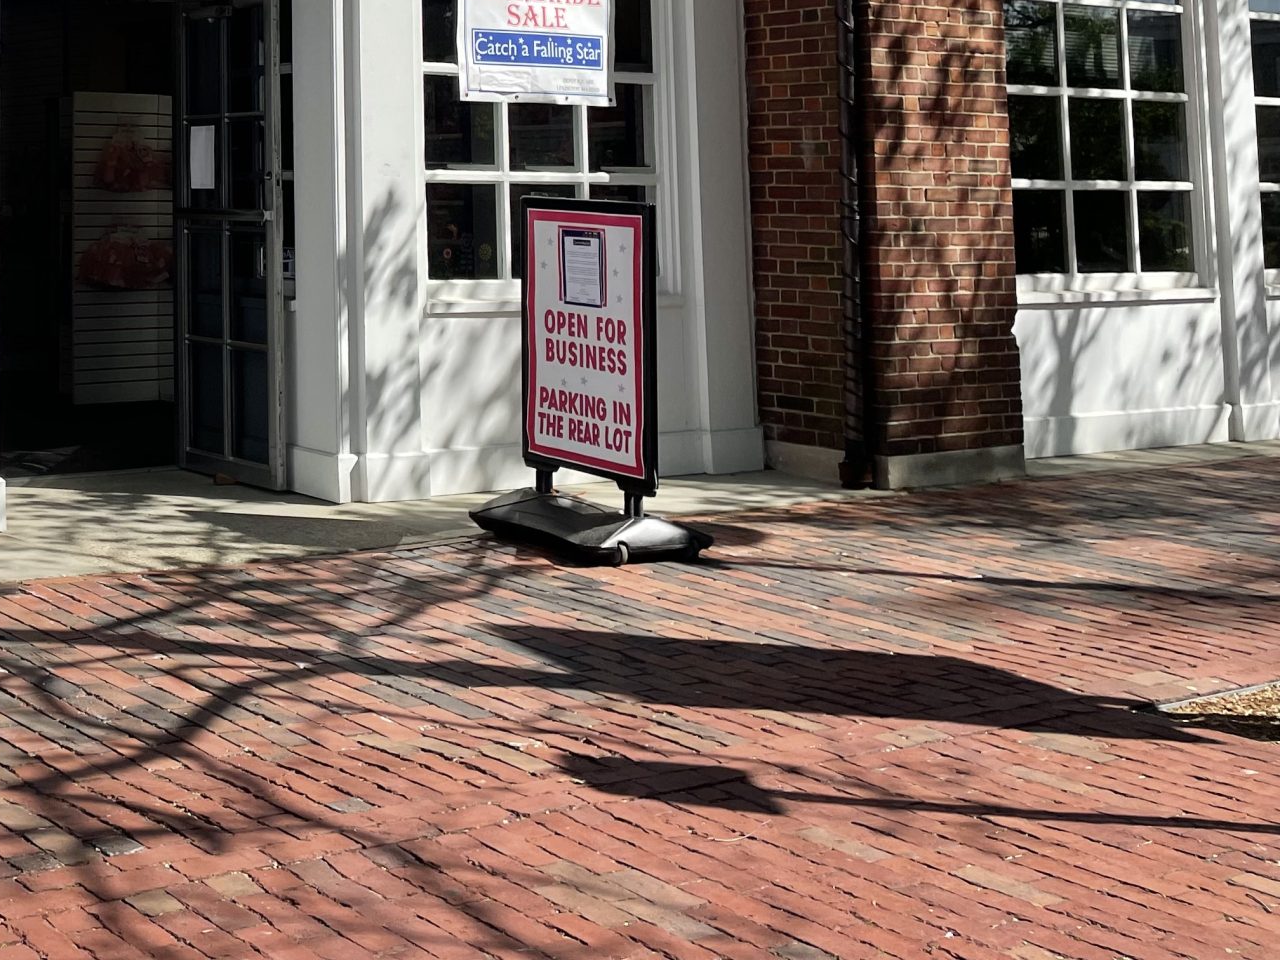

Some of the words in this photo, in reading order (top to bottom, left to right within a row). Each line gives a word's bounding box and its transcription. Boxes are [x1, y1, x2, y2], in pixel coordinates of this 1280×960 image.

[507, 4, 569, 28] SALE
[475, 37, 517, 57] Catch
[521, 44, 529, 57] a
[533, 40, 573, 63] Falling
[576, 42, 601, 61] Star
[544, 309, 589, 339] OPEN
[596, 317, 627, 345] FOR
[545, 338, 627, 376] BUSINESS
[539, 386, 607, 422] PARKING
[613, 400, 631, 426] IN
[537, 412, 564, 438] THE
[568, 418, 600, 446] REAR
[605, 426, 632, 454] LOT
